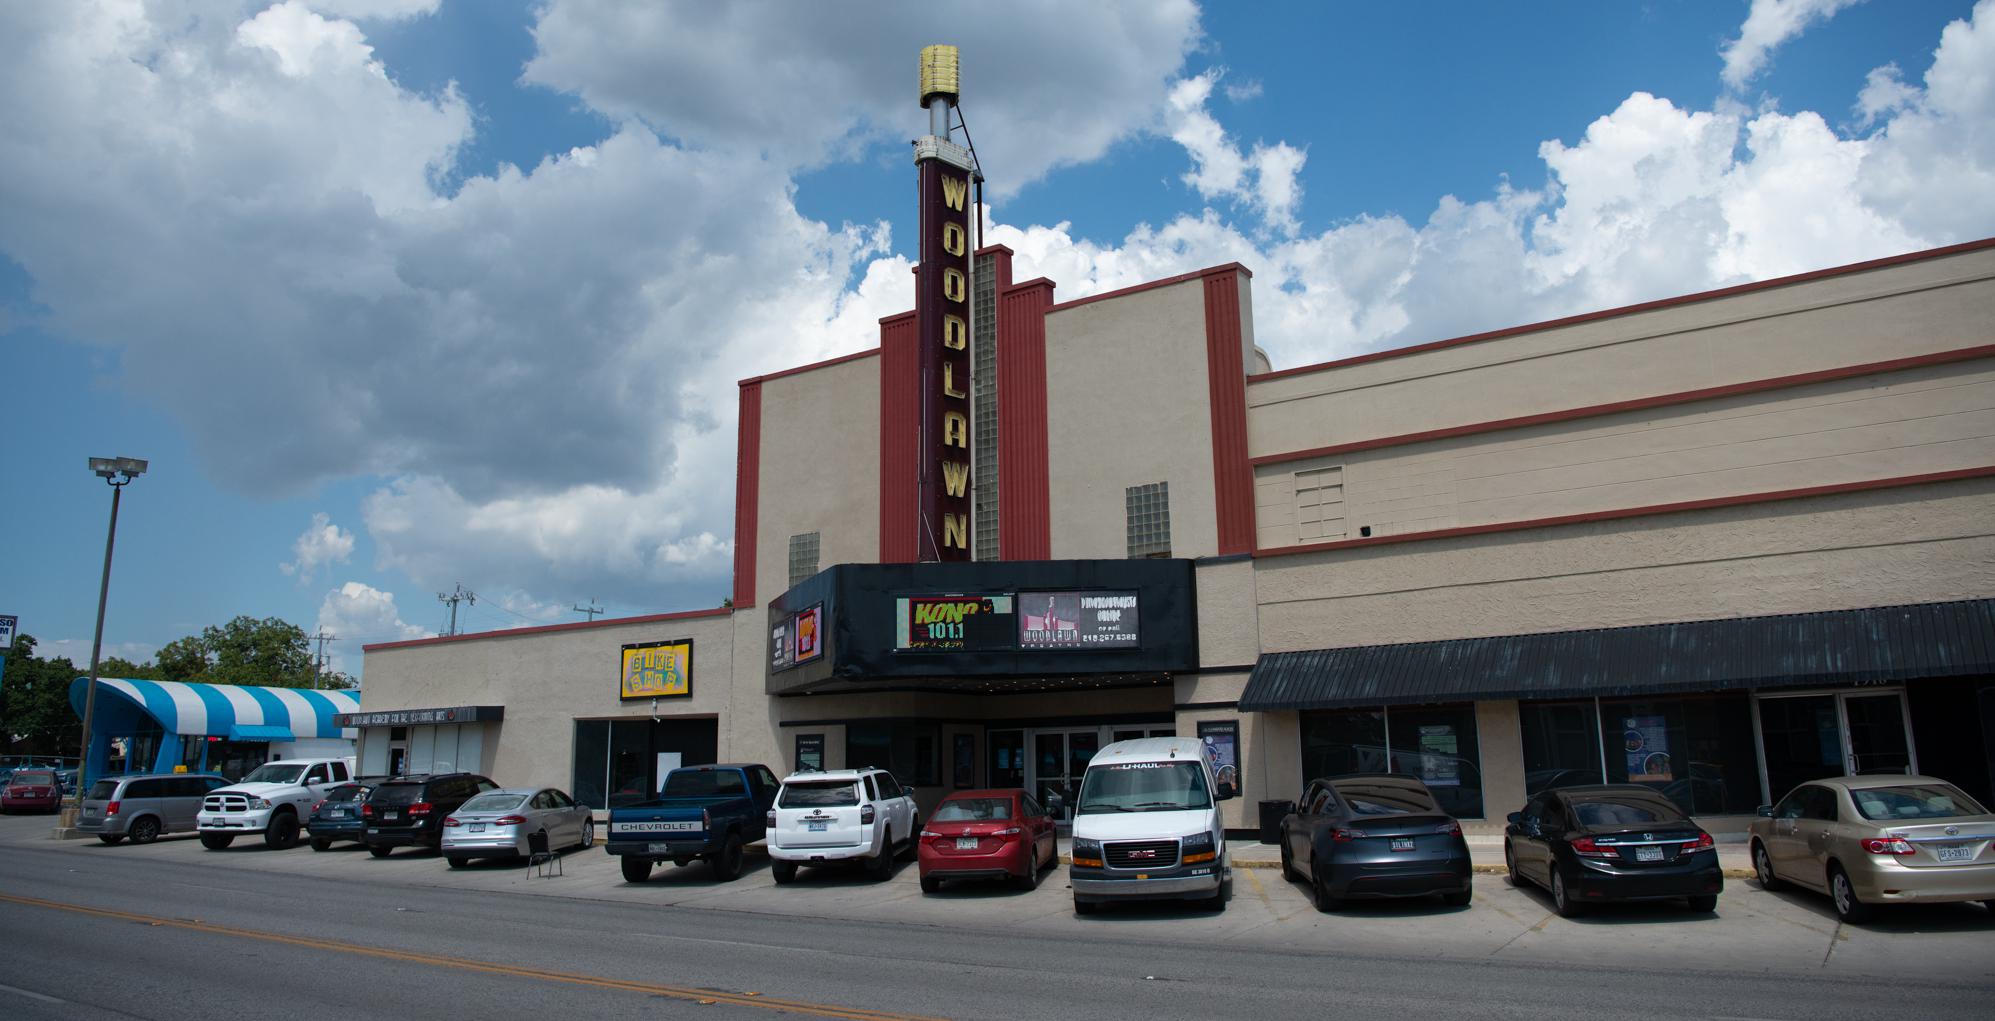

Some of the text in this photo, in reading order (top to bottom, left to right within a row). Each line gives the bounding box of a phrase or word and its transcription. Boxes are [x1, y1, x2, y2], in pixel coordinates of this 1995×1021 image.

[941, 174, 970, 550] WOODLAWN
[927, 622, 964, 639] 101.1
[1023, 630, 1078, 642] WOODLAWN
[633, 652, 673, 669] BIKE
[632, 673, 675, 690] SHOP
[621, 823, 694, 831] CHEVROLET
